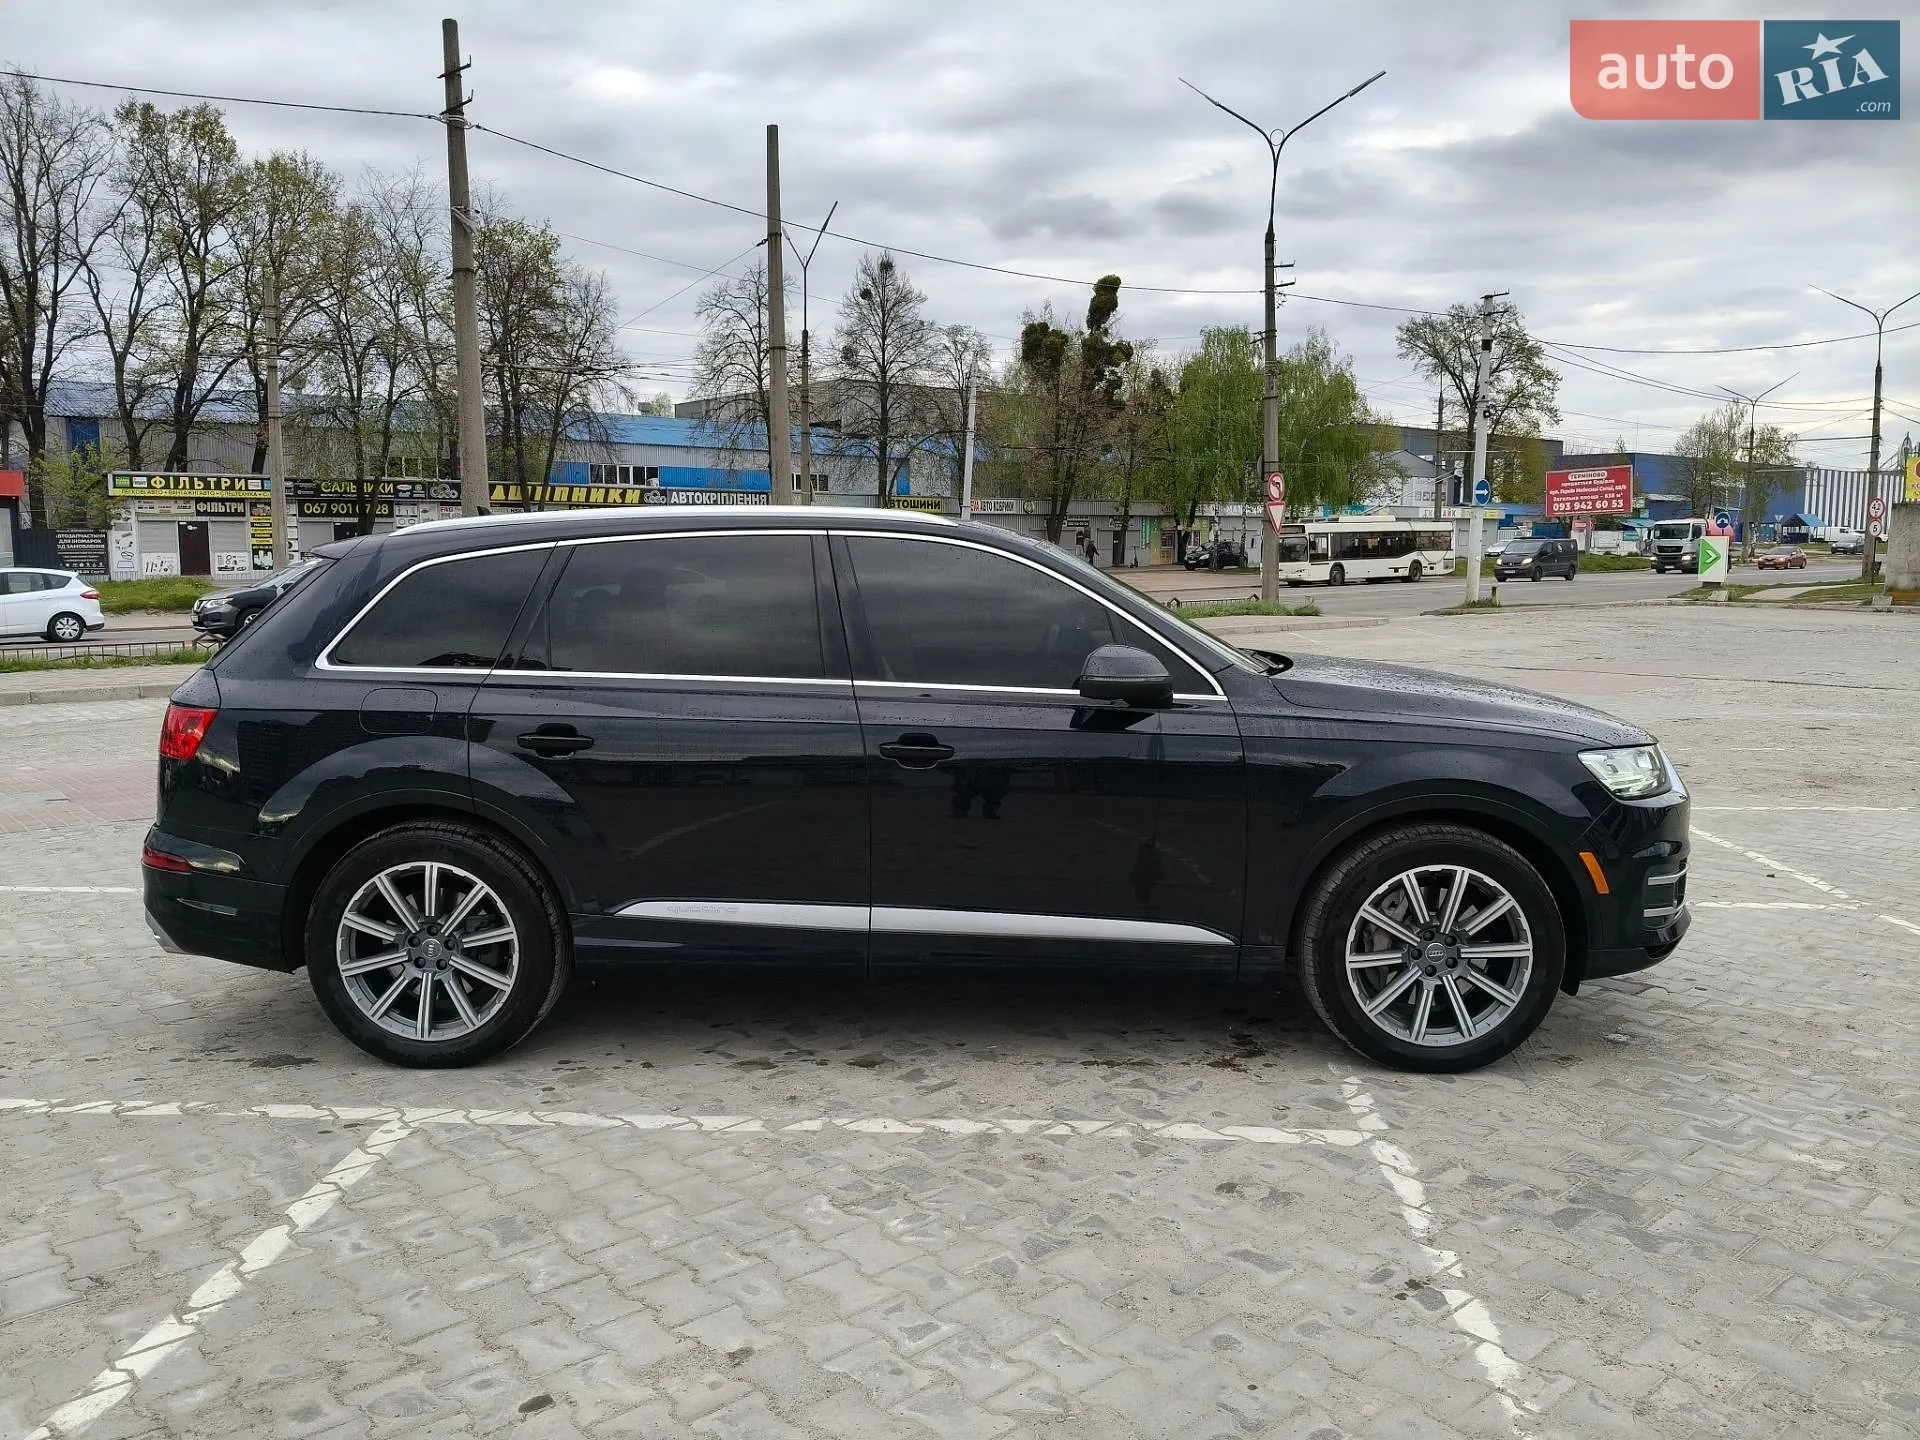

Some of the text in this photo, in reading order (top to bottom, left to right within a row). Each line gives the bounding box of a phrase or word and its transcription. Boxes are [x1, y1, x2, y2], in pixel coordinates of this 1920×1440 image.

[1570, 471, 1606, 480] ТЕРМІНОВО
[150, 475, 246, 491] ФІЛЬТРИ
[490, 484, 641, 504] ДШИПНИКИ
[670, 491, 767, 505] АВТОКРІПЛЕННЯ
[196, 502, 245, 513] ФІЛЬТРИ
[303, 503, 327, 514] 067
[330, 503, 352, 514] 901
[375, 503, 389, 515] 28
[889, 499, 941, 510] ВТОШИНИ
[1553, 499, 1624, 512] 093 942 60 53
[1872, 524, 1878, 533] 5
